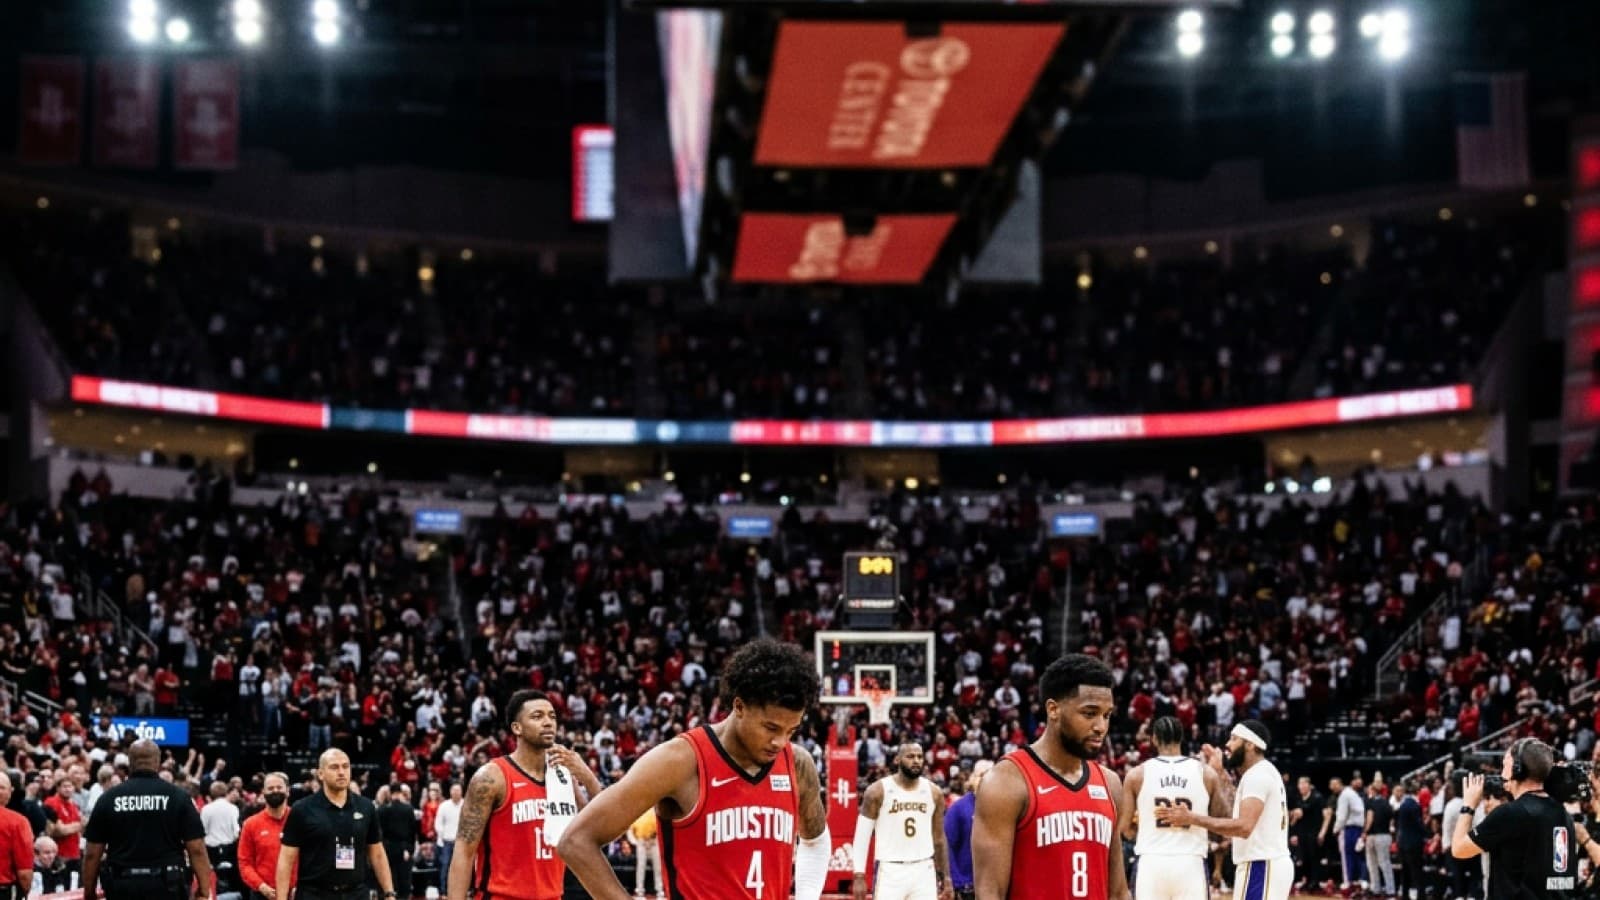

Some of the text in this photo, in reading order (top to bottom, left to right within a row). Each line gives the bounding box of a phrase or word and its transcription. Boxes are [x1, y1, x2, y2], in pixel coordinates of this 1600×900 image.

[827, 61, 890, 150] CENTER
[114, 795, 169, 812] SECURITY
[706, 805, 794, 847] HOUSTON
[904, 816, 917, 838] 6
[1037, 810, 1113, 848] HOUSTON
[745, 850, 765, 900] 4
[1072, 851, 1088, 898] 8
